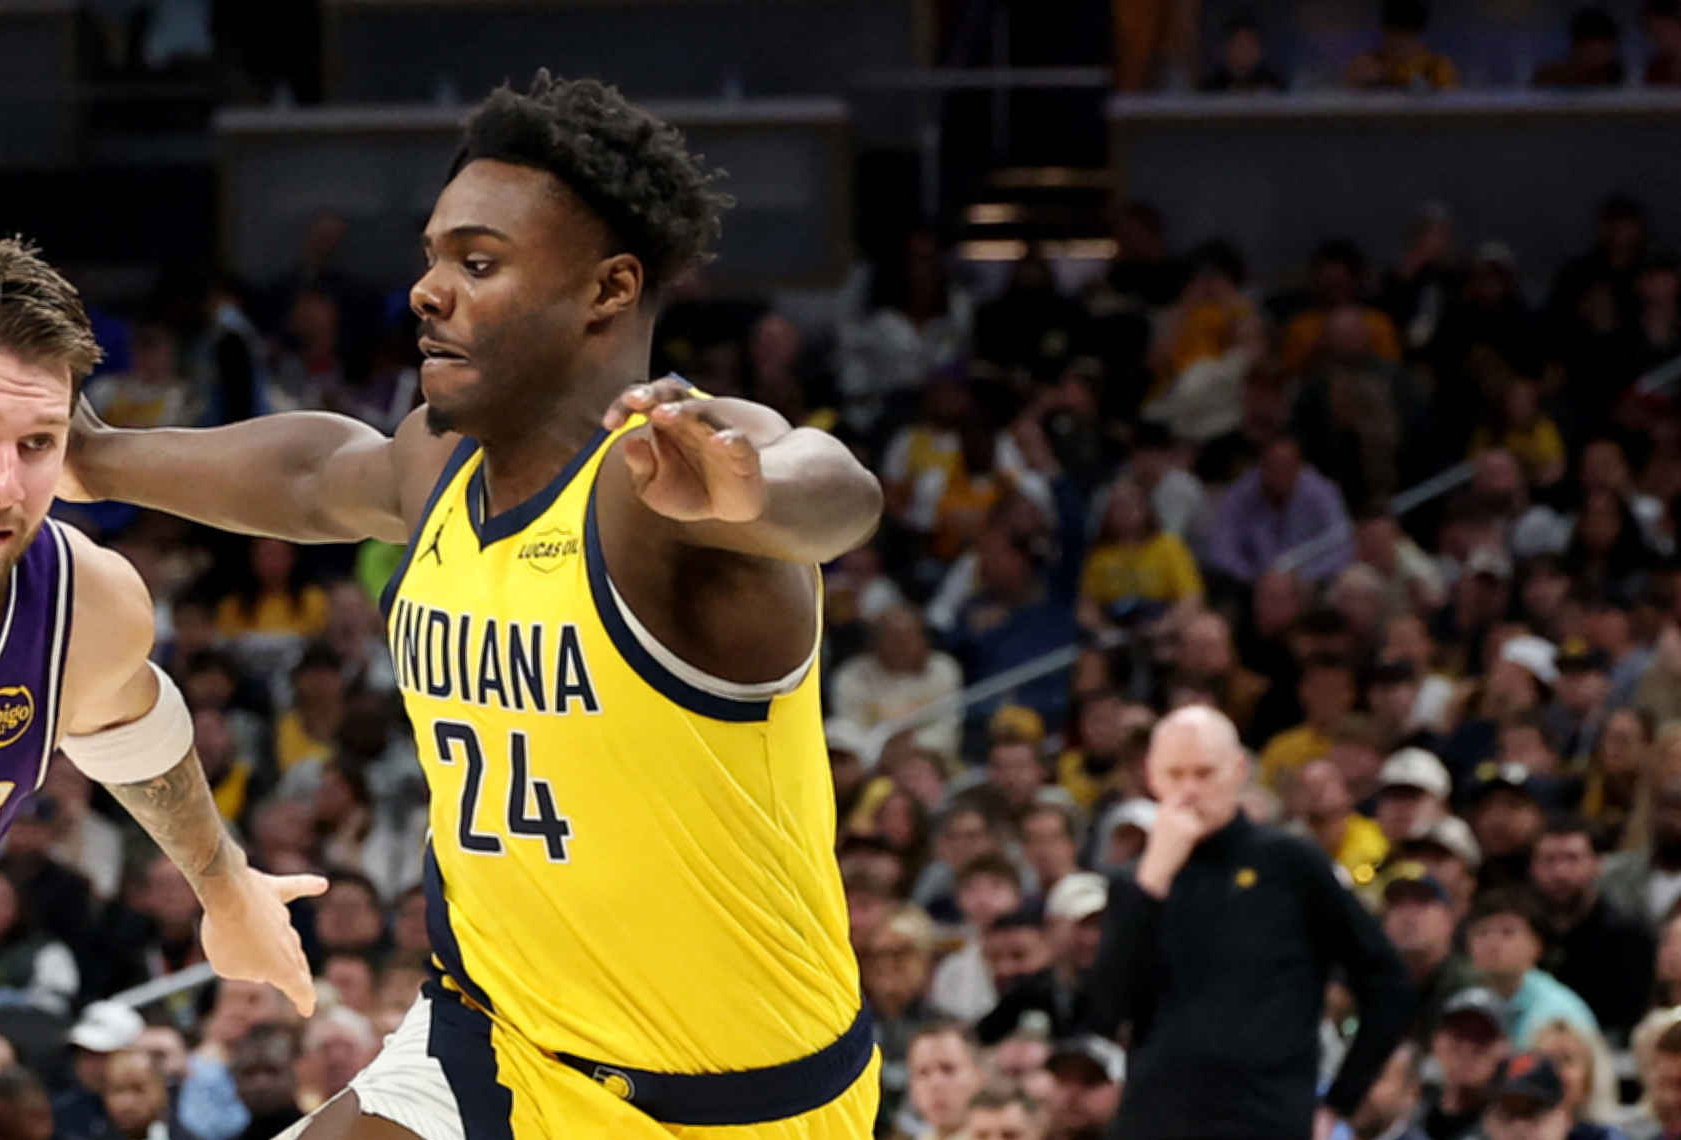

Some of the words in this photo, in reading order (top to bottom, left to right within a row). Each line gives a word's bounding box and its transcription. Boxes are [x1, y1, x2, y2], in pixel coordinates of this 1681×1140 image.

[518, 542, 562, 559] LUCAS
[393, 598, 600, 713] INDIANA
[433, 719, 574, 864] 24
